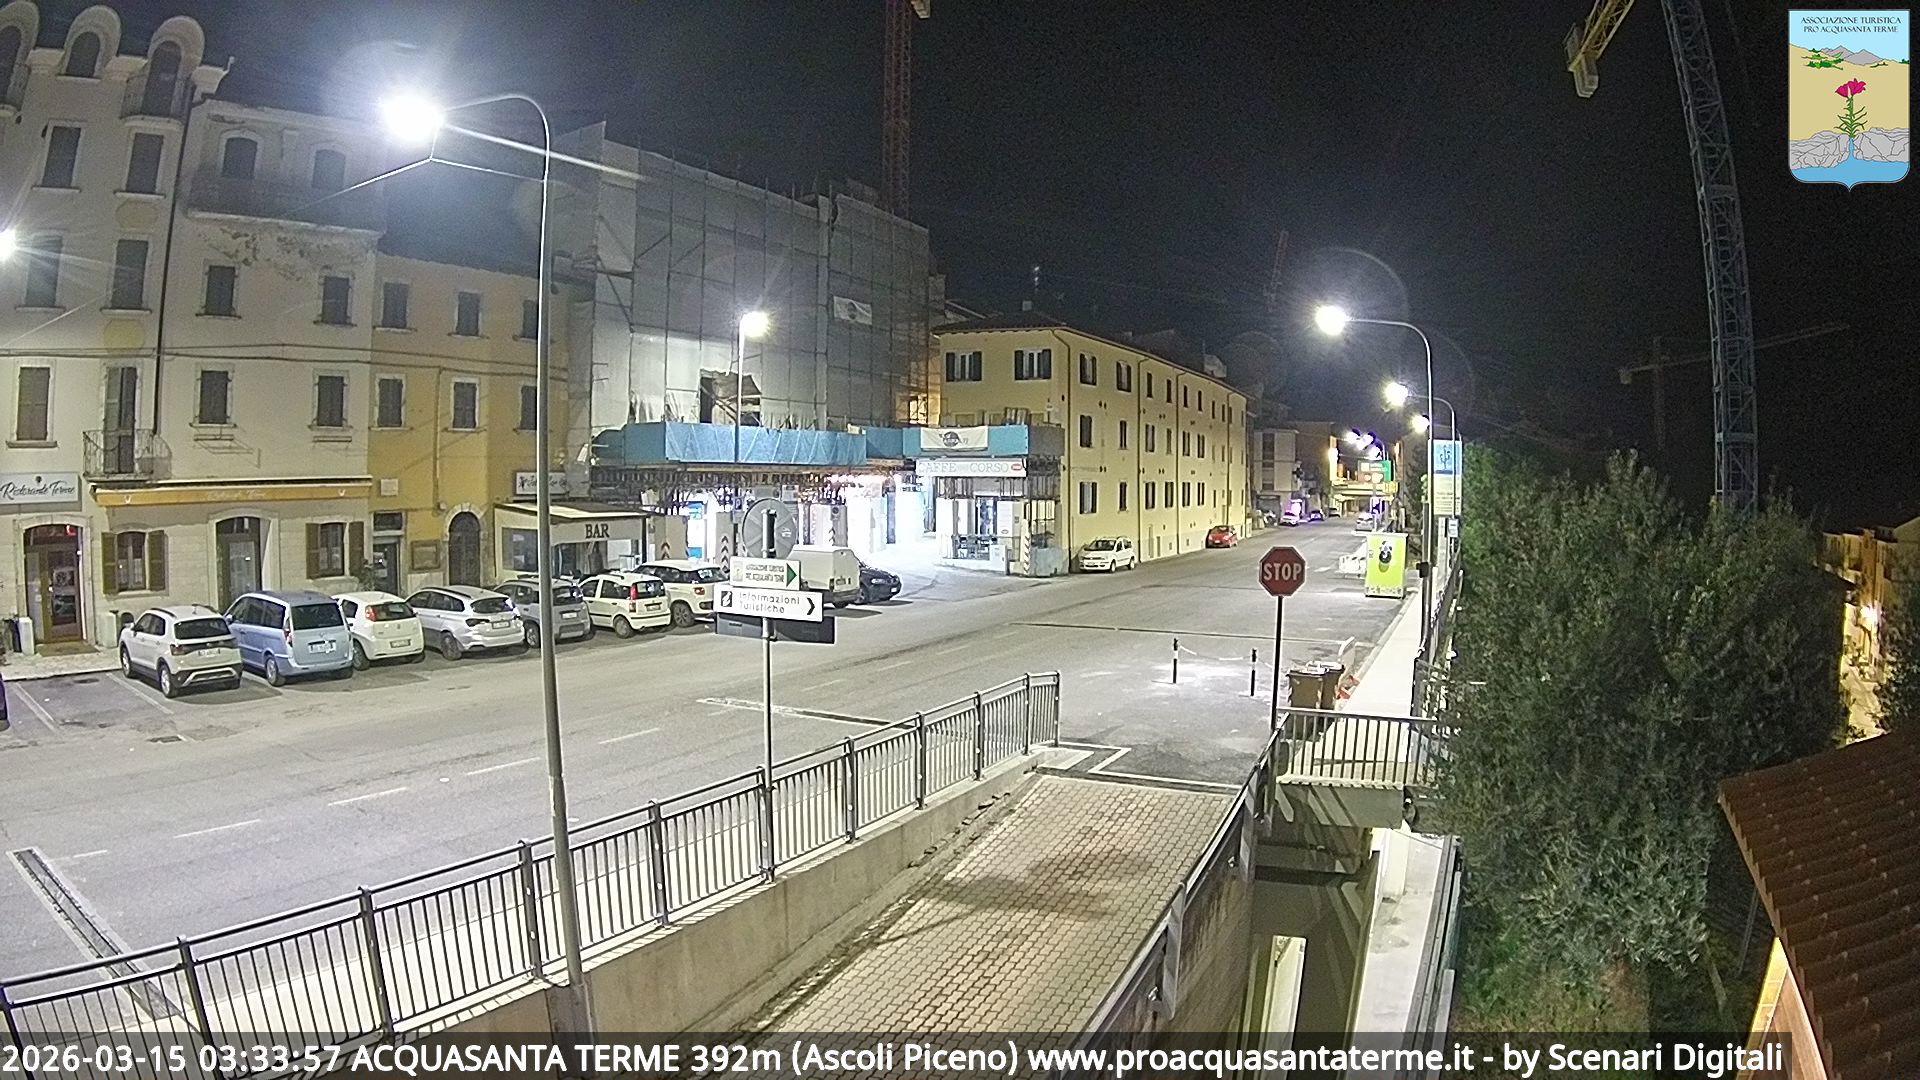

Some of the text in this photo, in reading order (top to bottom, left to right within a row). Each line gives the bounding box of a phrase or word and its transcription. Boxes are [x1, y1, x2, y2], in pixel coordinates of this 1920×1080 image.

[970, 463, 1008, 472] CORSO
[585, 523, 610, 539] BAR
[1263, 563, 1302, 581] STOP
[739, 592, 801, 605] Informazioni
[739, 601, 785, 614] Turistiche
